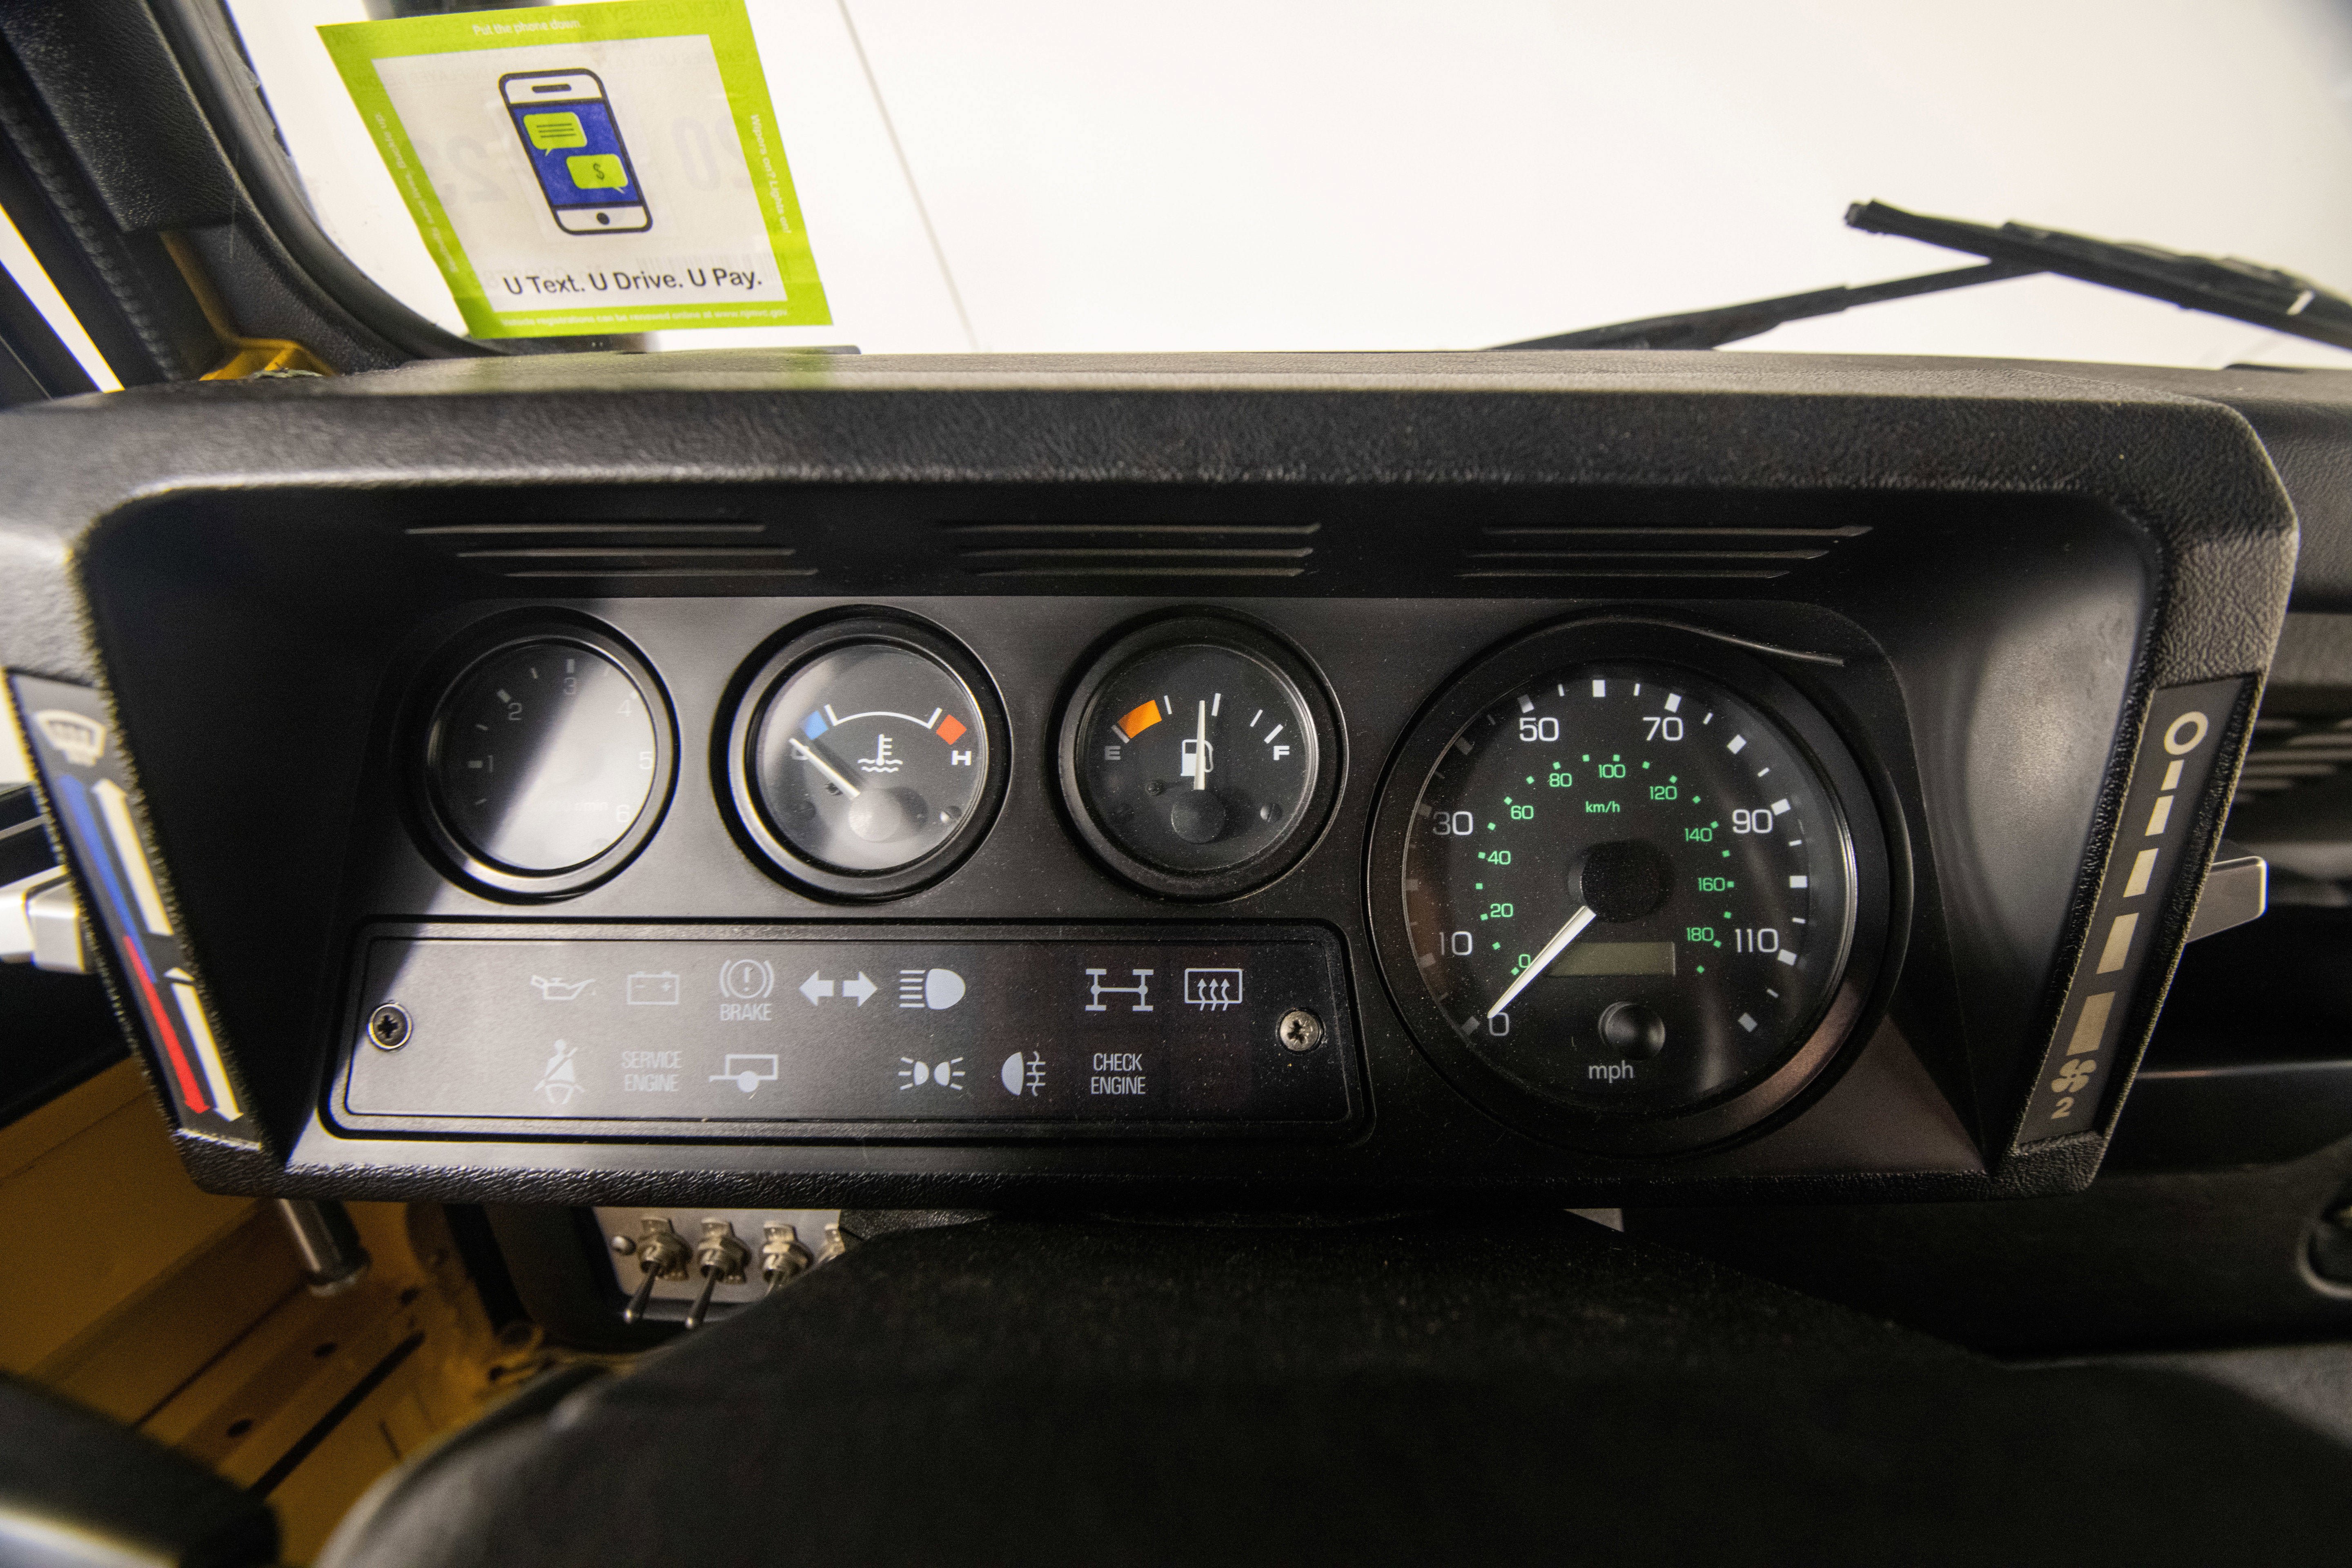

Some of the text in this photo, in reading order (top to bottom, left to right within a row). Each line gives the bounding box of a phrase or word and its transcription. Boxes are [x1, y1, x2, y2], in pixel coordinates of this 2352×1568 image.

[472, 24, 493, 36] Put
[493, 22, 512, 34] the
[513, 21, 548, 35] phone
[751, 114, 768, 155] Wipers
[762, 157, 776, 178] on?
[768, 180, 784, 215] Lights
[502, 267, 762, 295] U Text. U Drive. U Pay.
[564, 677, 577, 695] 3
[508, 702, 523, 721] 2
[618, 700, 632, 717] 4
[1519, 717, 1560, 742] 50
[1642, 717, 1684, 741] 70
[639, 751, 653, 770] 5
[951, 750, 972, 766] H
[1105, 745, 1121, 761] E
[1273, 745, 1290, 761] F
[488, 754, 494, 773] 1
[1598, 764, 1626, 779] 100
[1549, 773, 1572, 788] 80
[1649, 785, 1678, 800] 120
[616, 804, 631, 822] 6
[1510, 805, 1534, 820] 60
[1585, 800, 1621, 813] km/h
[1432, 811, 1474, 836] 30
[1732, 808, 1773, 834] 90
[1684, 827, 1713, 842] 140
[1487, 850, 1512, 865] 40
[1697, 877, 1726, 892] 160
[1490, 903, 1514, 918] 20
[1439, 931, 1473, 956] 10
[1686, 927, 1714, 942] 180
[1735, 927, 1780, 953] 110
[1518, 953, 1531, 969] 0
[719, 1003, 773, 1021] BRAKE
[1488, 1012, 1510, 1036] 0
[621, 1050, 682, 1069] SERVICE
[1093, 1052, 1143, 1072] CHECK
[1588, 1060, 1634, 1084] mph
[624, 1073, 679, 1093] ENGINE
[1091, 1076, 1146, 1095] ENGINE
[2050, 1096, 2075, 1120] 2
